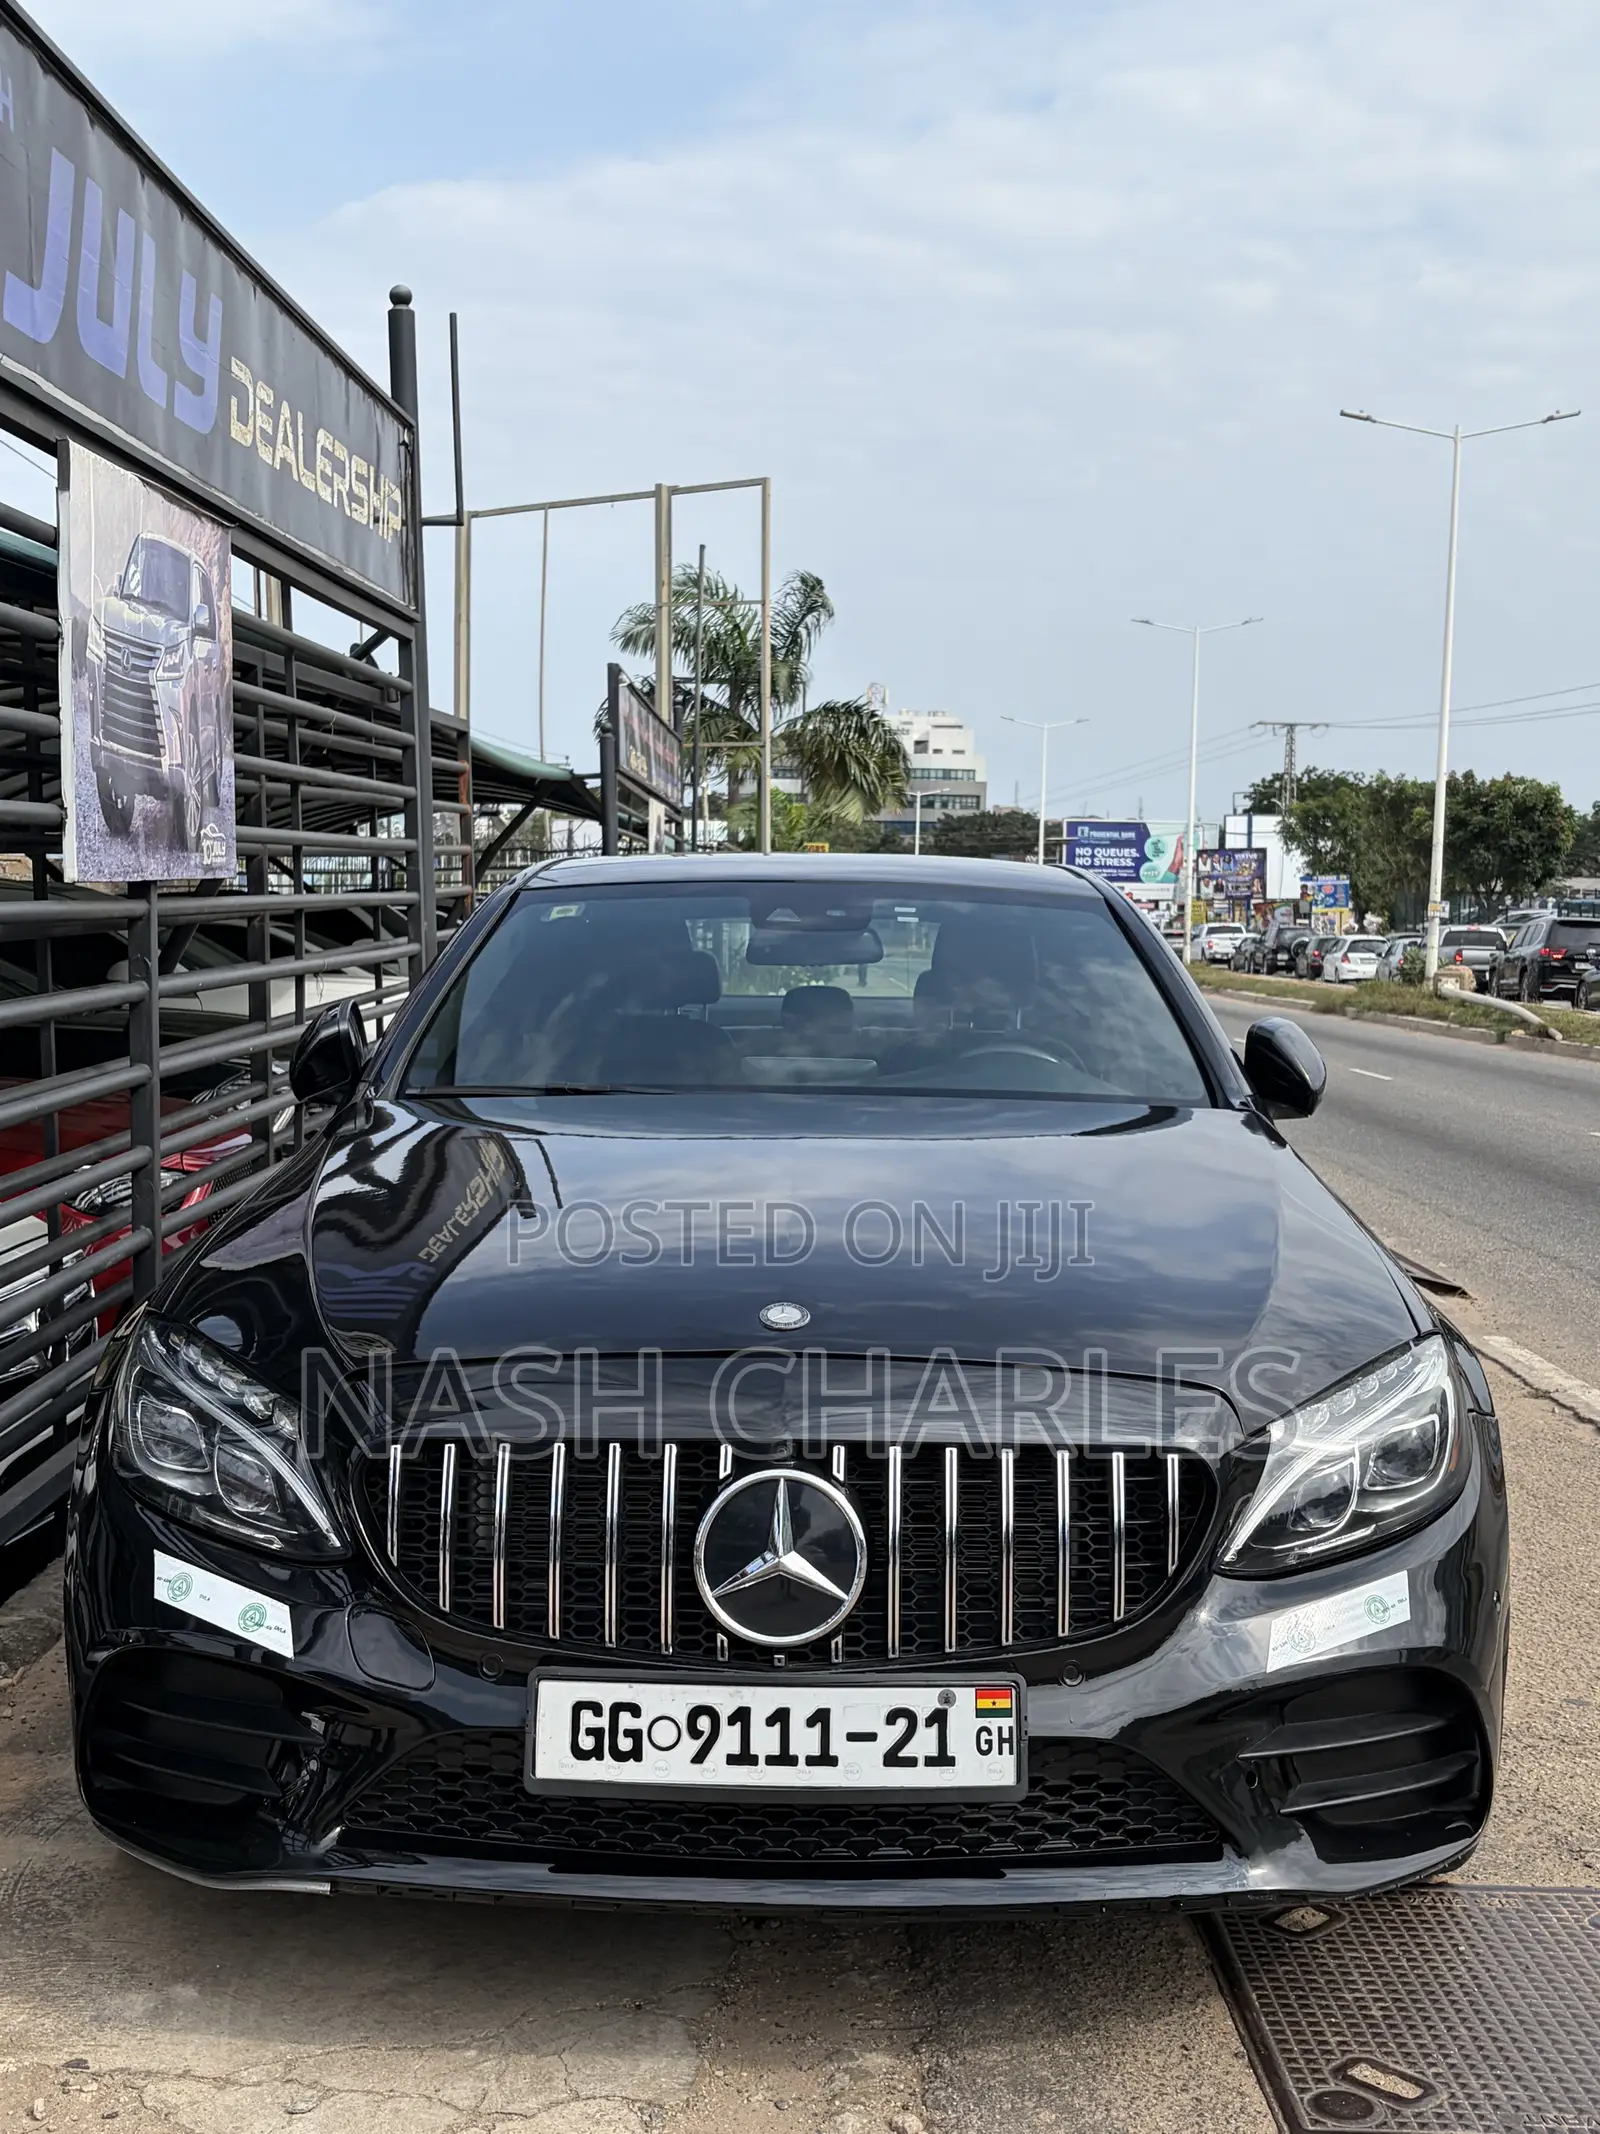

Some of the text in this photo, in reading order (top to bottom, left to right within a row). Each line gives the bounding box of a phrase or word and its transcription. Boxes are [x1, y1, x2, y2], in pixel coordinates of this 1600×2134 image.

[3, 147, 402, 543] JULY DEALERSHIP
[1075, 847, 1092, 857] NO
[1075, 857, 1091, 866] NO
[570, 1700, 956, 1768] GG 9111-21
[975, 1725, 1015, 1757] GH
